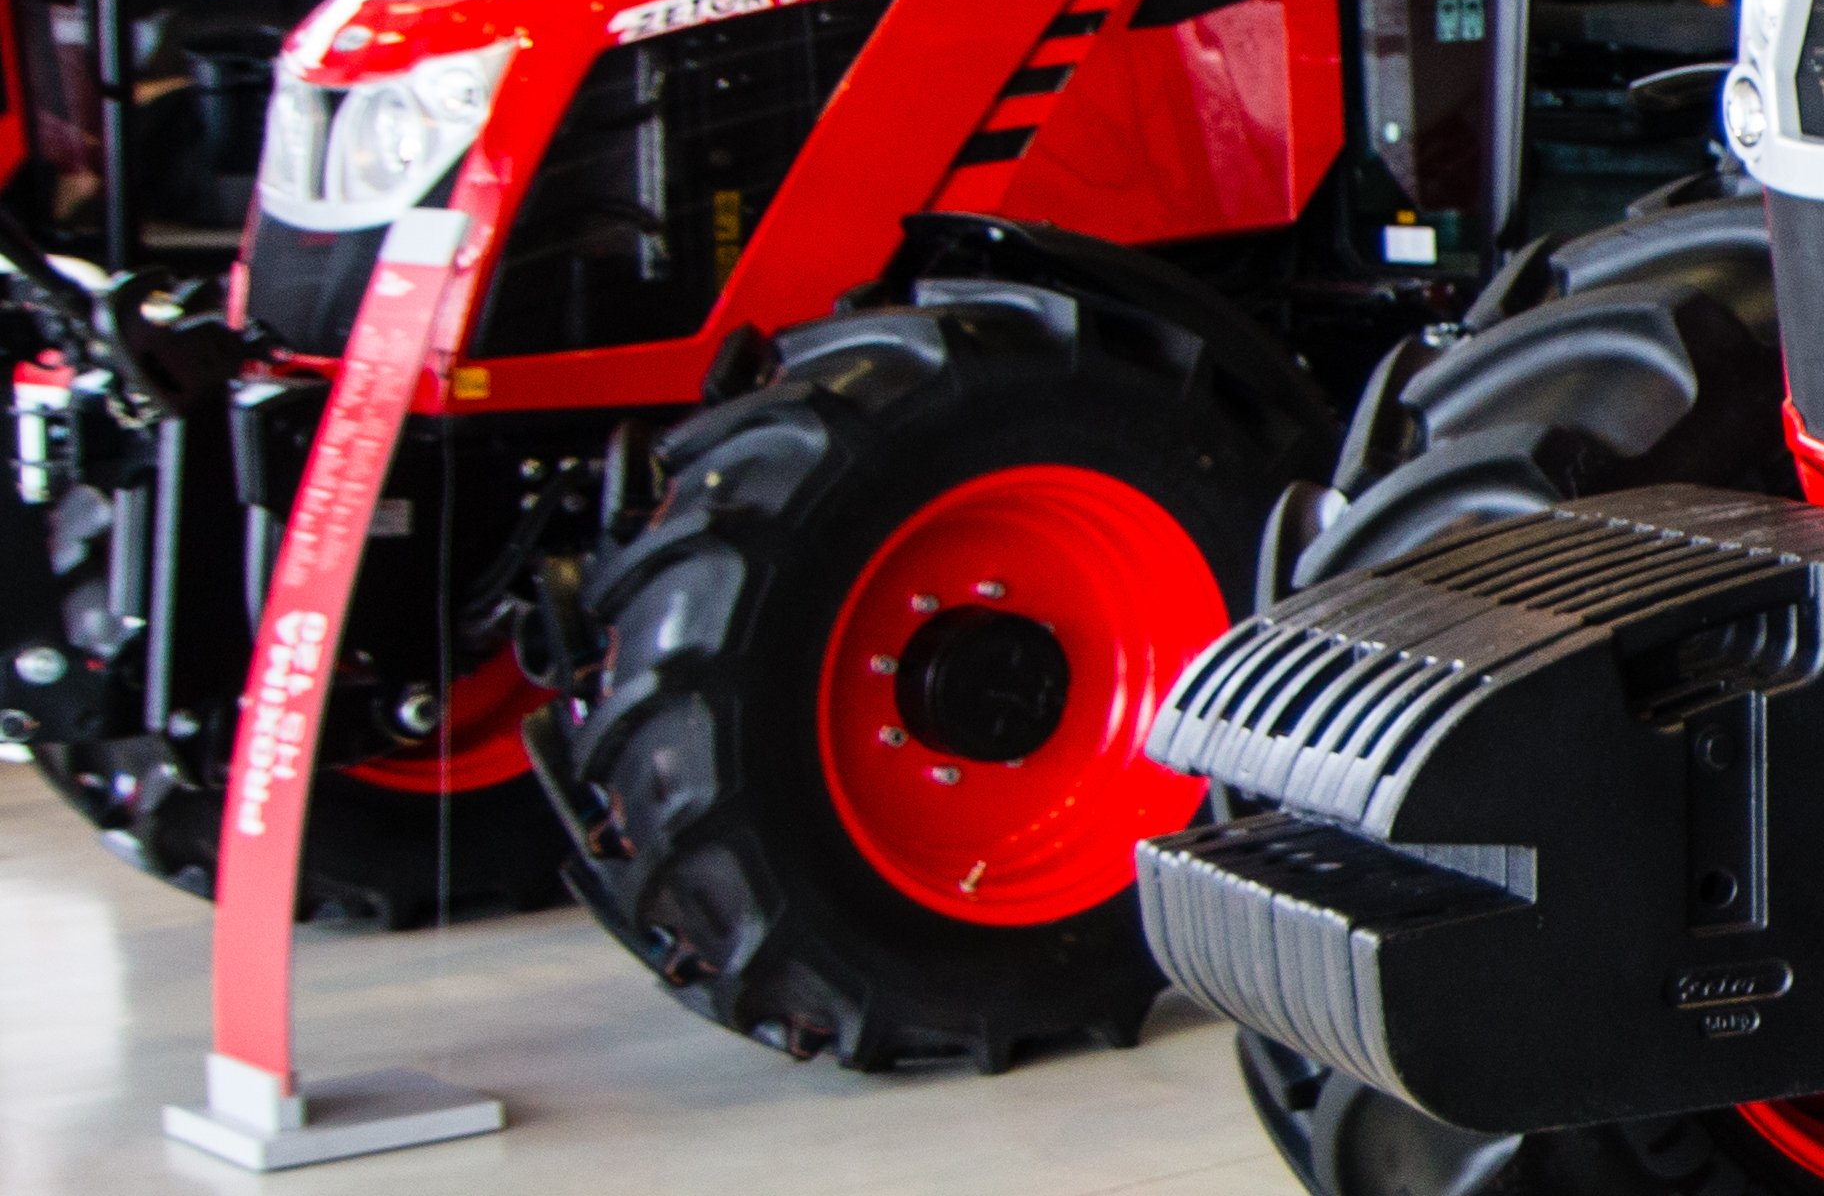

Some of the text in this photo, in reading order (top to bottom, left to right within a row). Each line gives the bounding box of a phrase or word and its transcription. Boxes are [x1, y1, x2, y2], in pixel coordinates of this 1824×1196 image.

[237, 610, 304, 836] PROXIMA
[272, 611, 328, 780] HS 120
